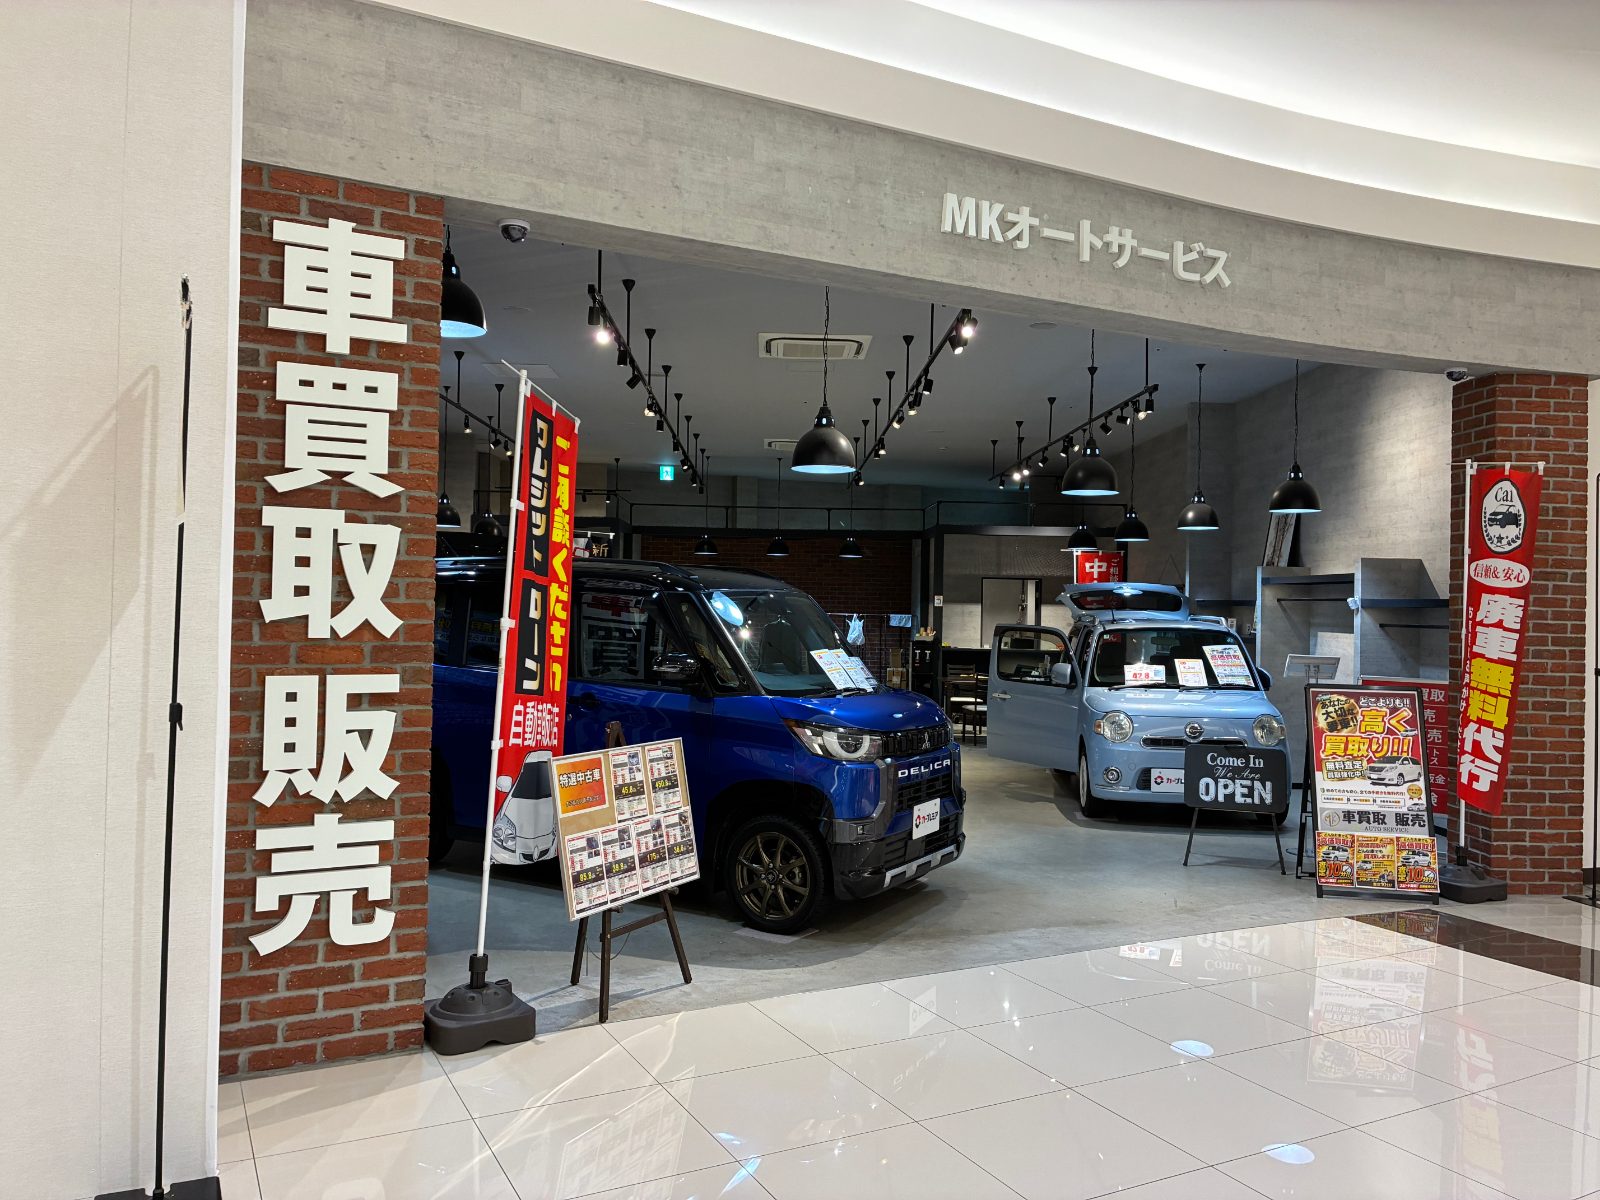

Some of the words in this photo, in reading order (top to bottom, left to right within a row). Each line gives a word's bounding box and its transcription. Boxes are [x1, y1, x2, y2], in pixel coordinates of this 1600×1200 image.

[941, 192, 1231, 288] MKオートサービス
[1459, 593, 1525, 792] 廃車無料代行
[1359, 707, 1412, 735] 高く
[1323, 733, 1411, 760] 買取り!!
[898, 759, 951, 778] DELICA
[1206, 752, 1246, 767] Come
[1249, 754, 1264, 768] In
[559, 768, 602, 788] 特選中古車
[1213, 766, 1233, 778] We
[1235, 768, 1262, 780] Are
[1199, 777, 1273, 805] OPEN
[1341, 810, 1388, 826] 車買取
[1395, 812, 1427, 828] 販売
